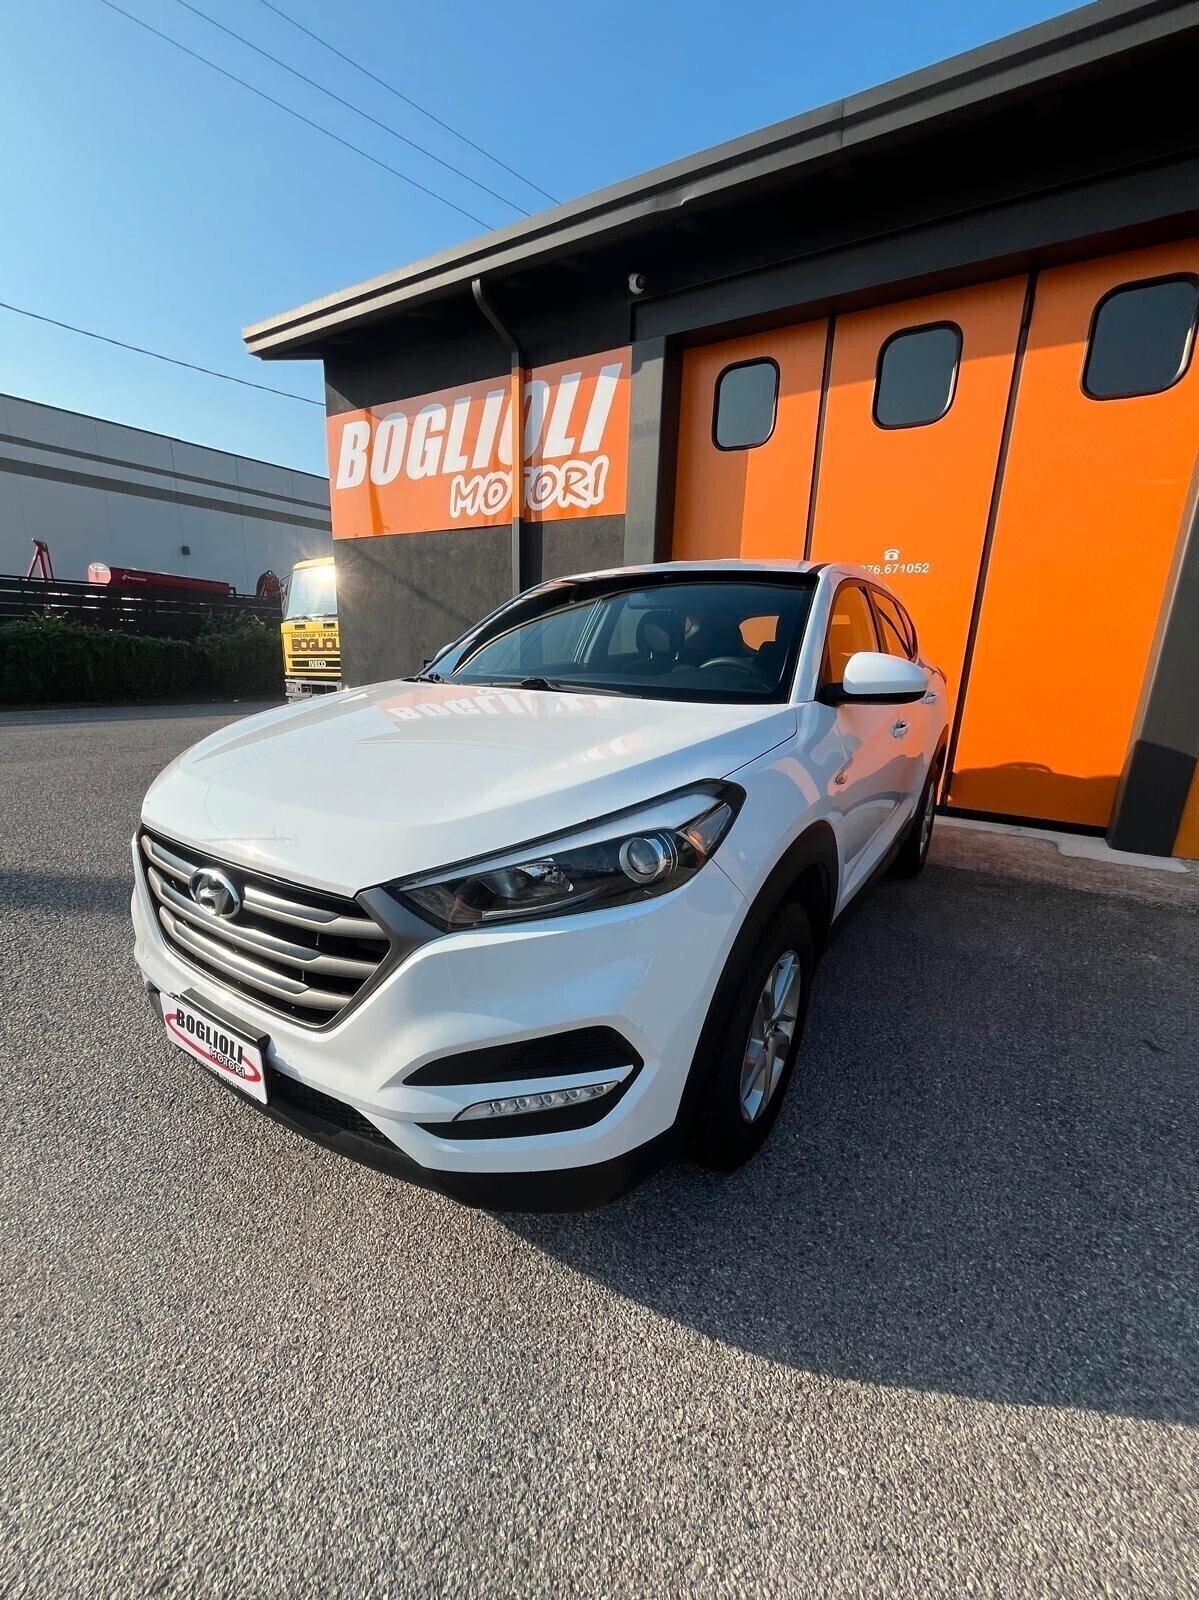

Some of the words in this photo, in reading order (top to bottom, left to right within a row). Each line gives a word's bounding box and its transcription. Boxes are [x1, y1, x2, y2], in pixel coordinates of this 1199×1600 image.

[335, 362, 623, 490] BOGLIOLI
[176, 1008, 243, 1065] BOGLIOLI
[209, 1046, 246, 1078] MOTORI
